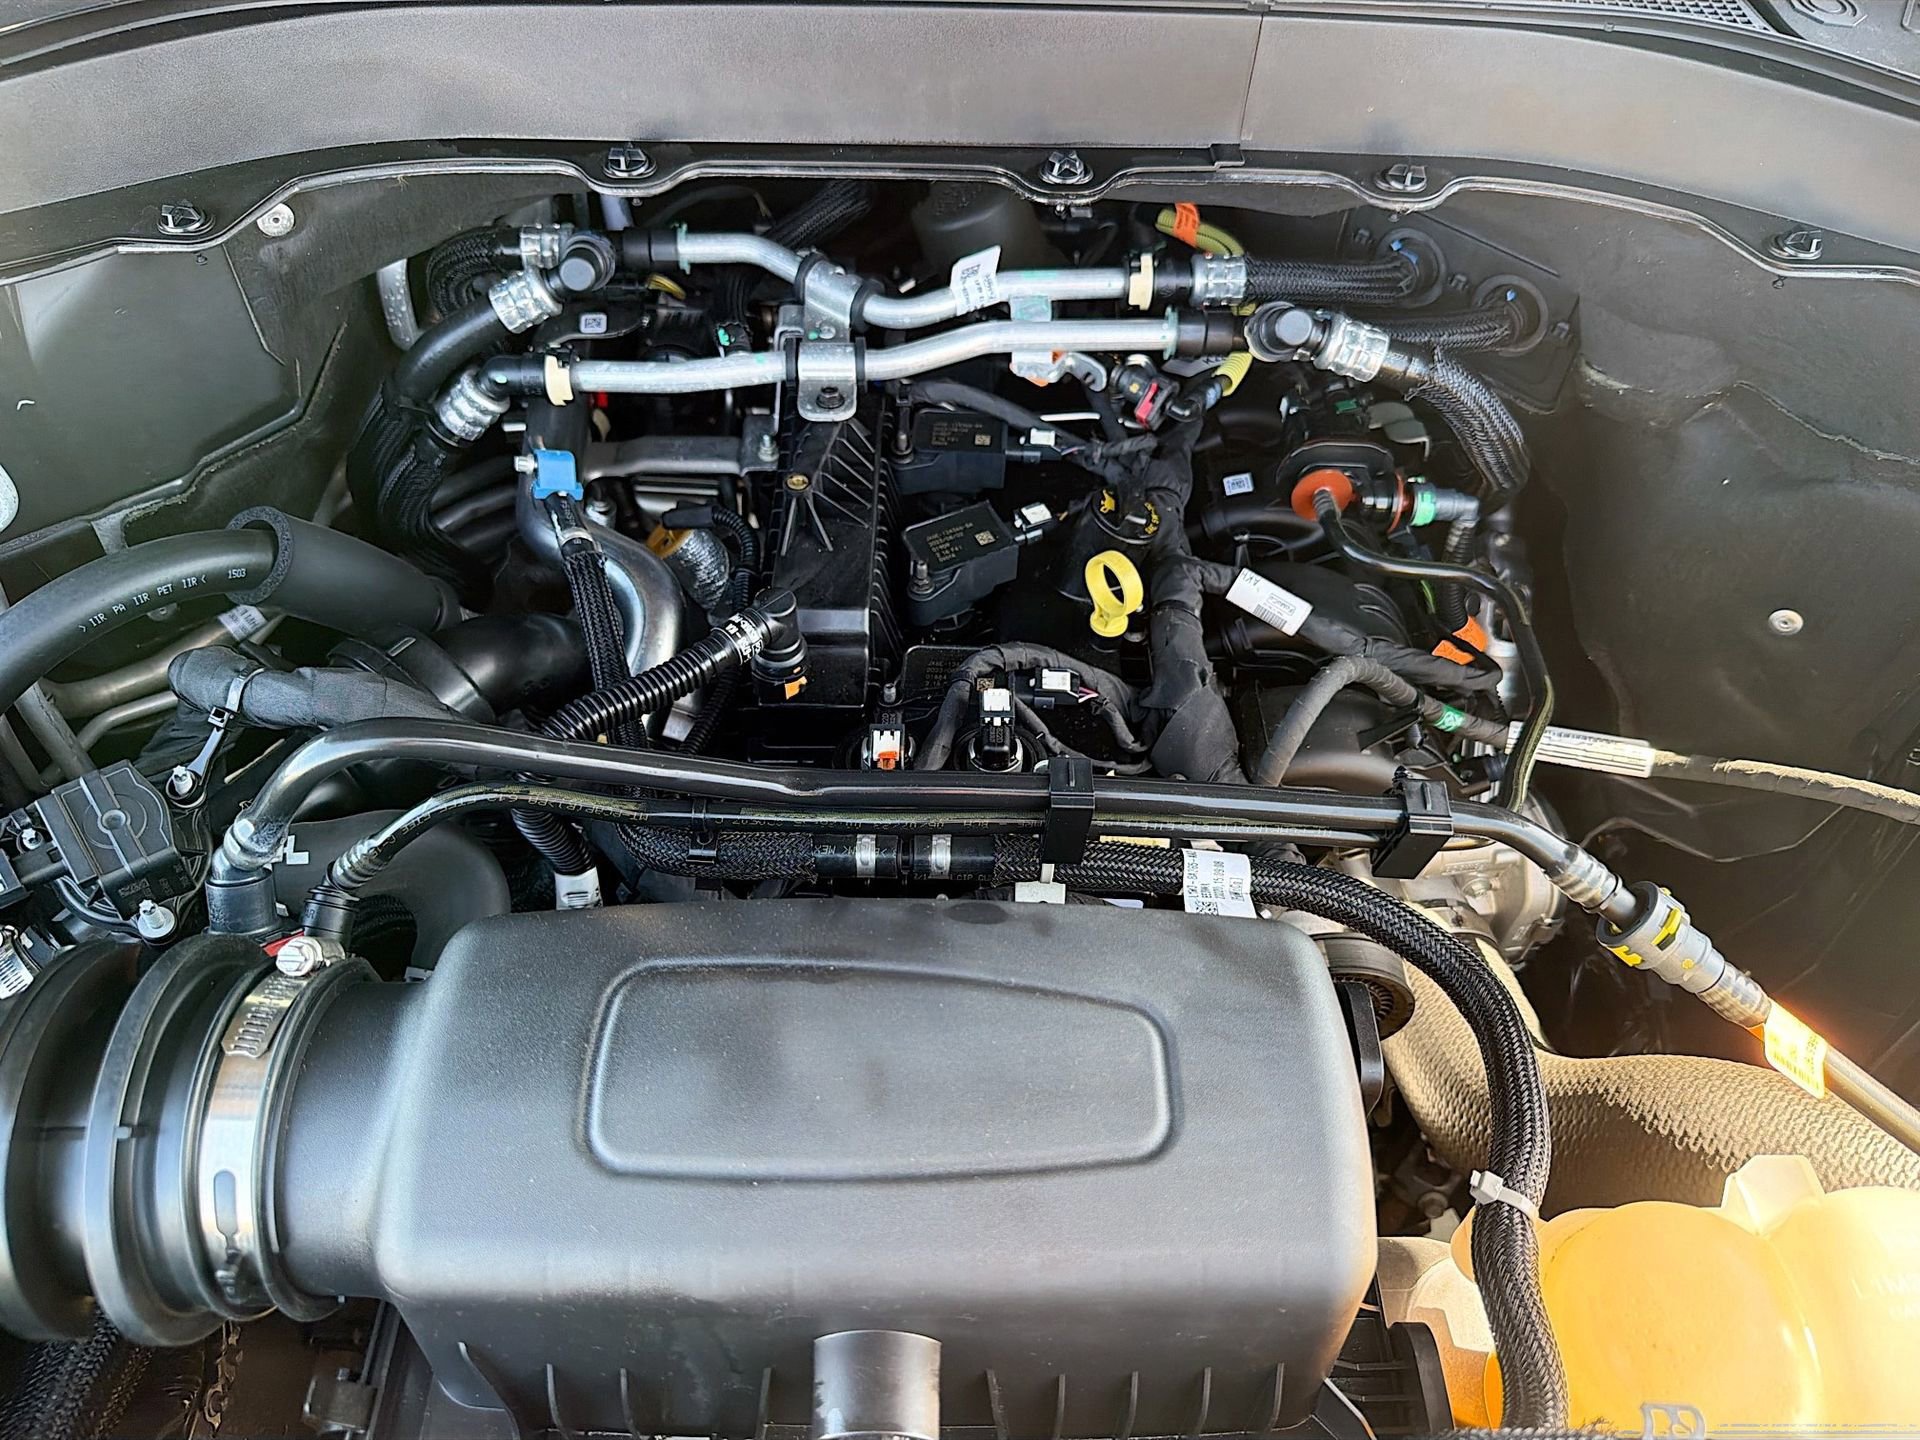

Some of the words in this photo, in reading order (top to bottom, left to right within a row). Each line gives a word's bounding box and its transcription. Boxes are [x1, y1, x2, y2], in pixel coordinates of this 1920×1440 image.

[112, 603, 126, 615] PA
[133, 592, 150, 606] IIR
[157, 583, 173, 596] PET
[228, 568, 247, 579] 1503
